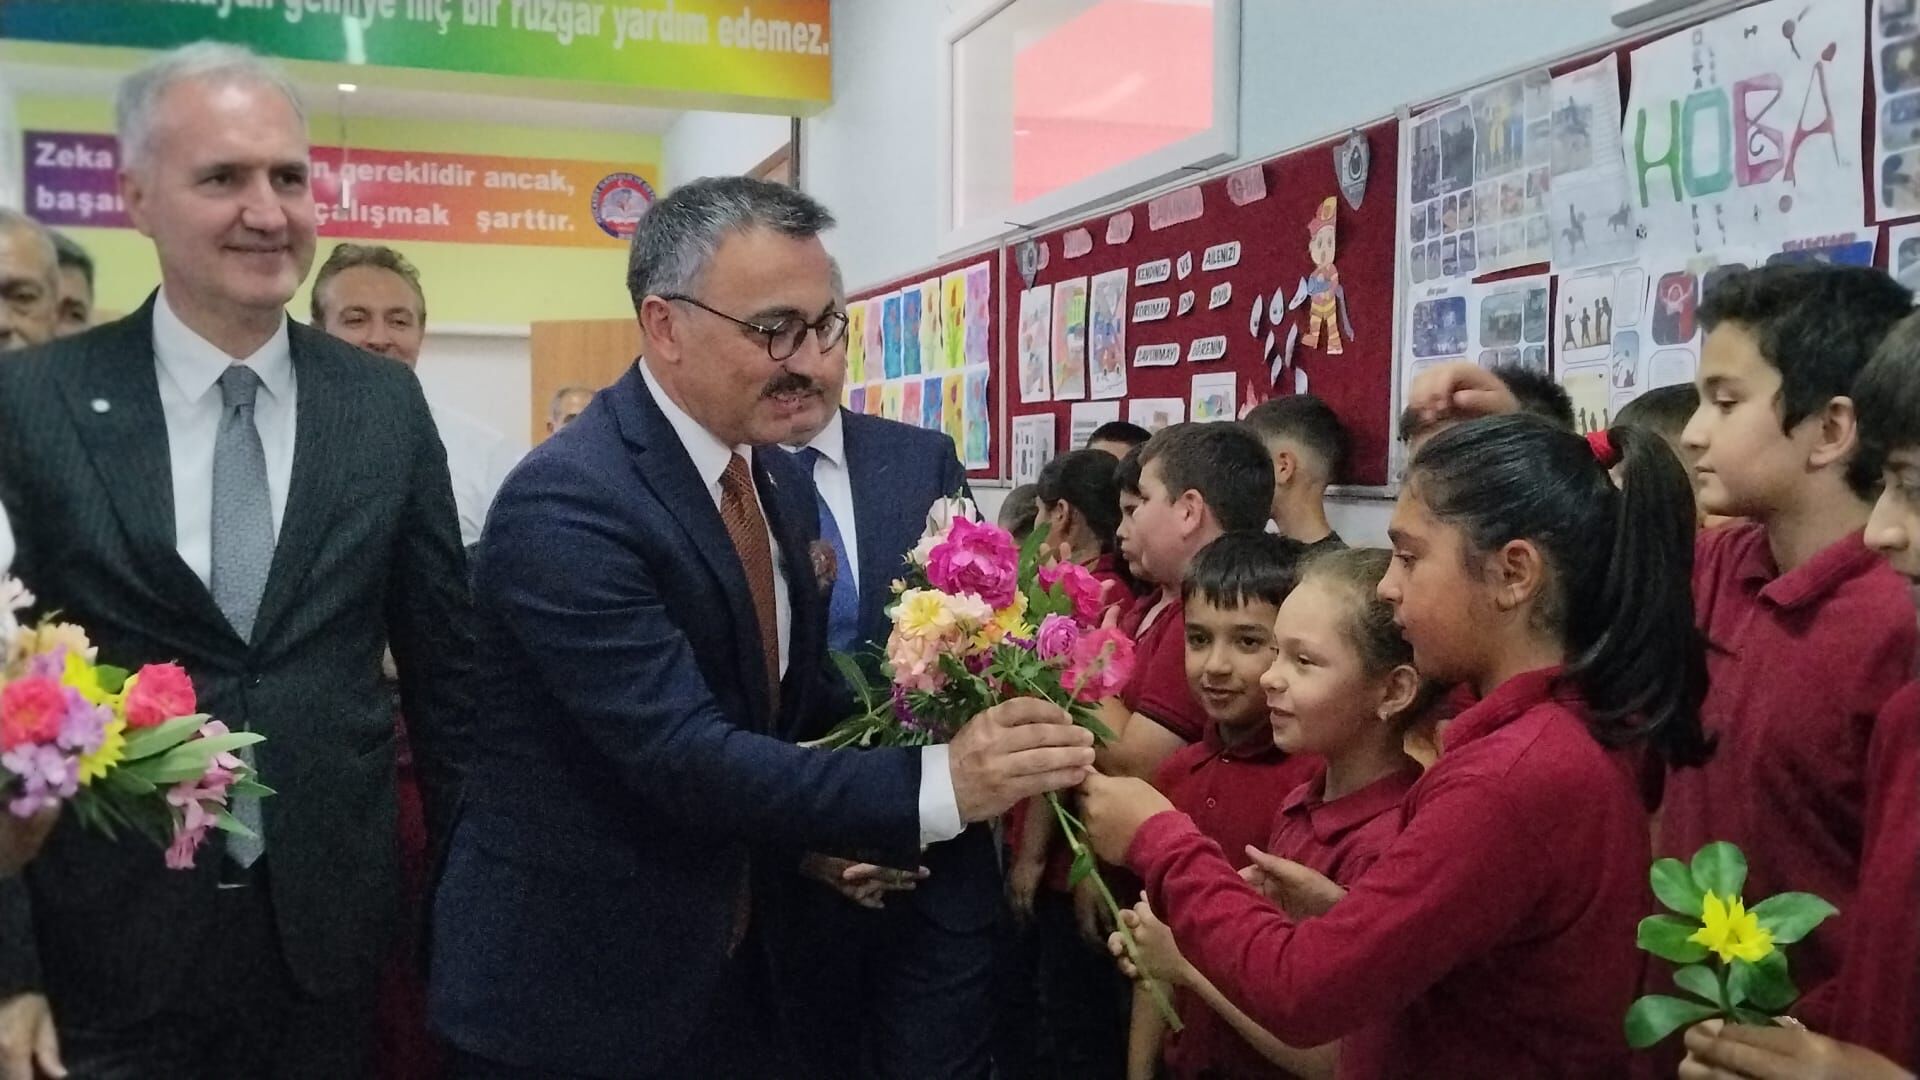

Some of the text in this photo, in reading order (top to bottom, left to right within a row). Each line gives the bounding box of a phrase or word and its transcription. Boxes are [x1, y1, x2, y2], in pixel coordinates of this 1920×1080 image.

[716, 8, 829, 56] edemez.
[35, 142, 113, 168] Zeka
[340, 161, 476, 187] gereklidir
[484, 169, 575, 197] ancak,
[314, 199, 449, 229] çalışmak
[476, 209, 575, 233] şarttır.
